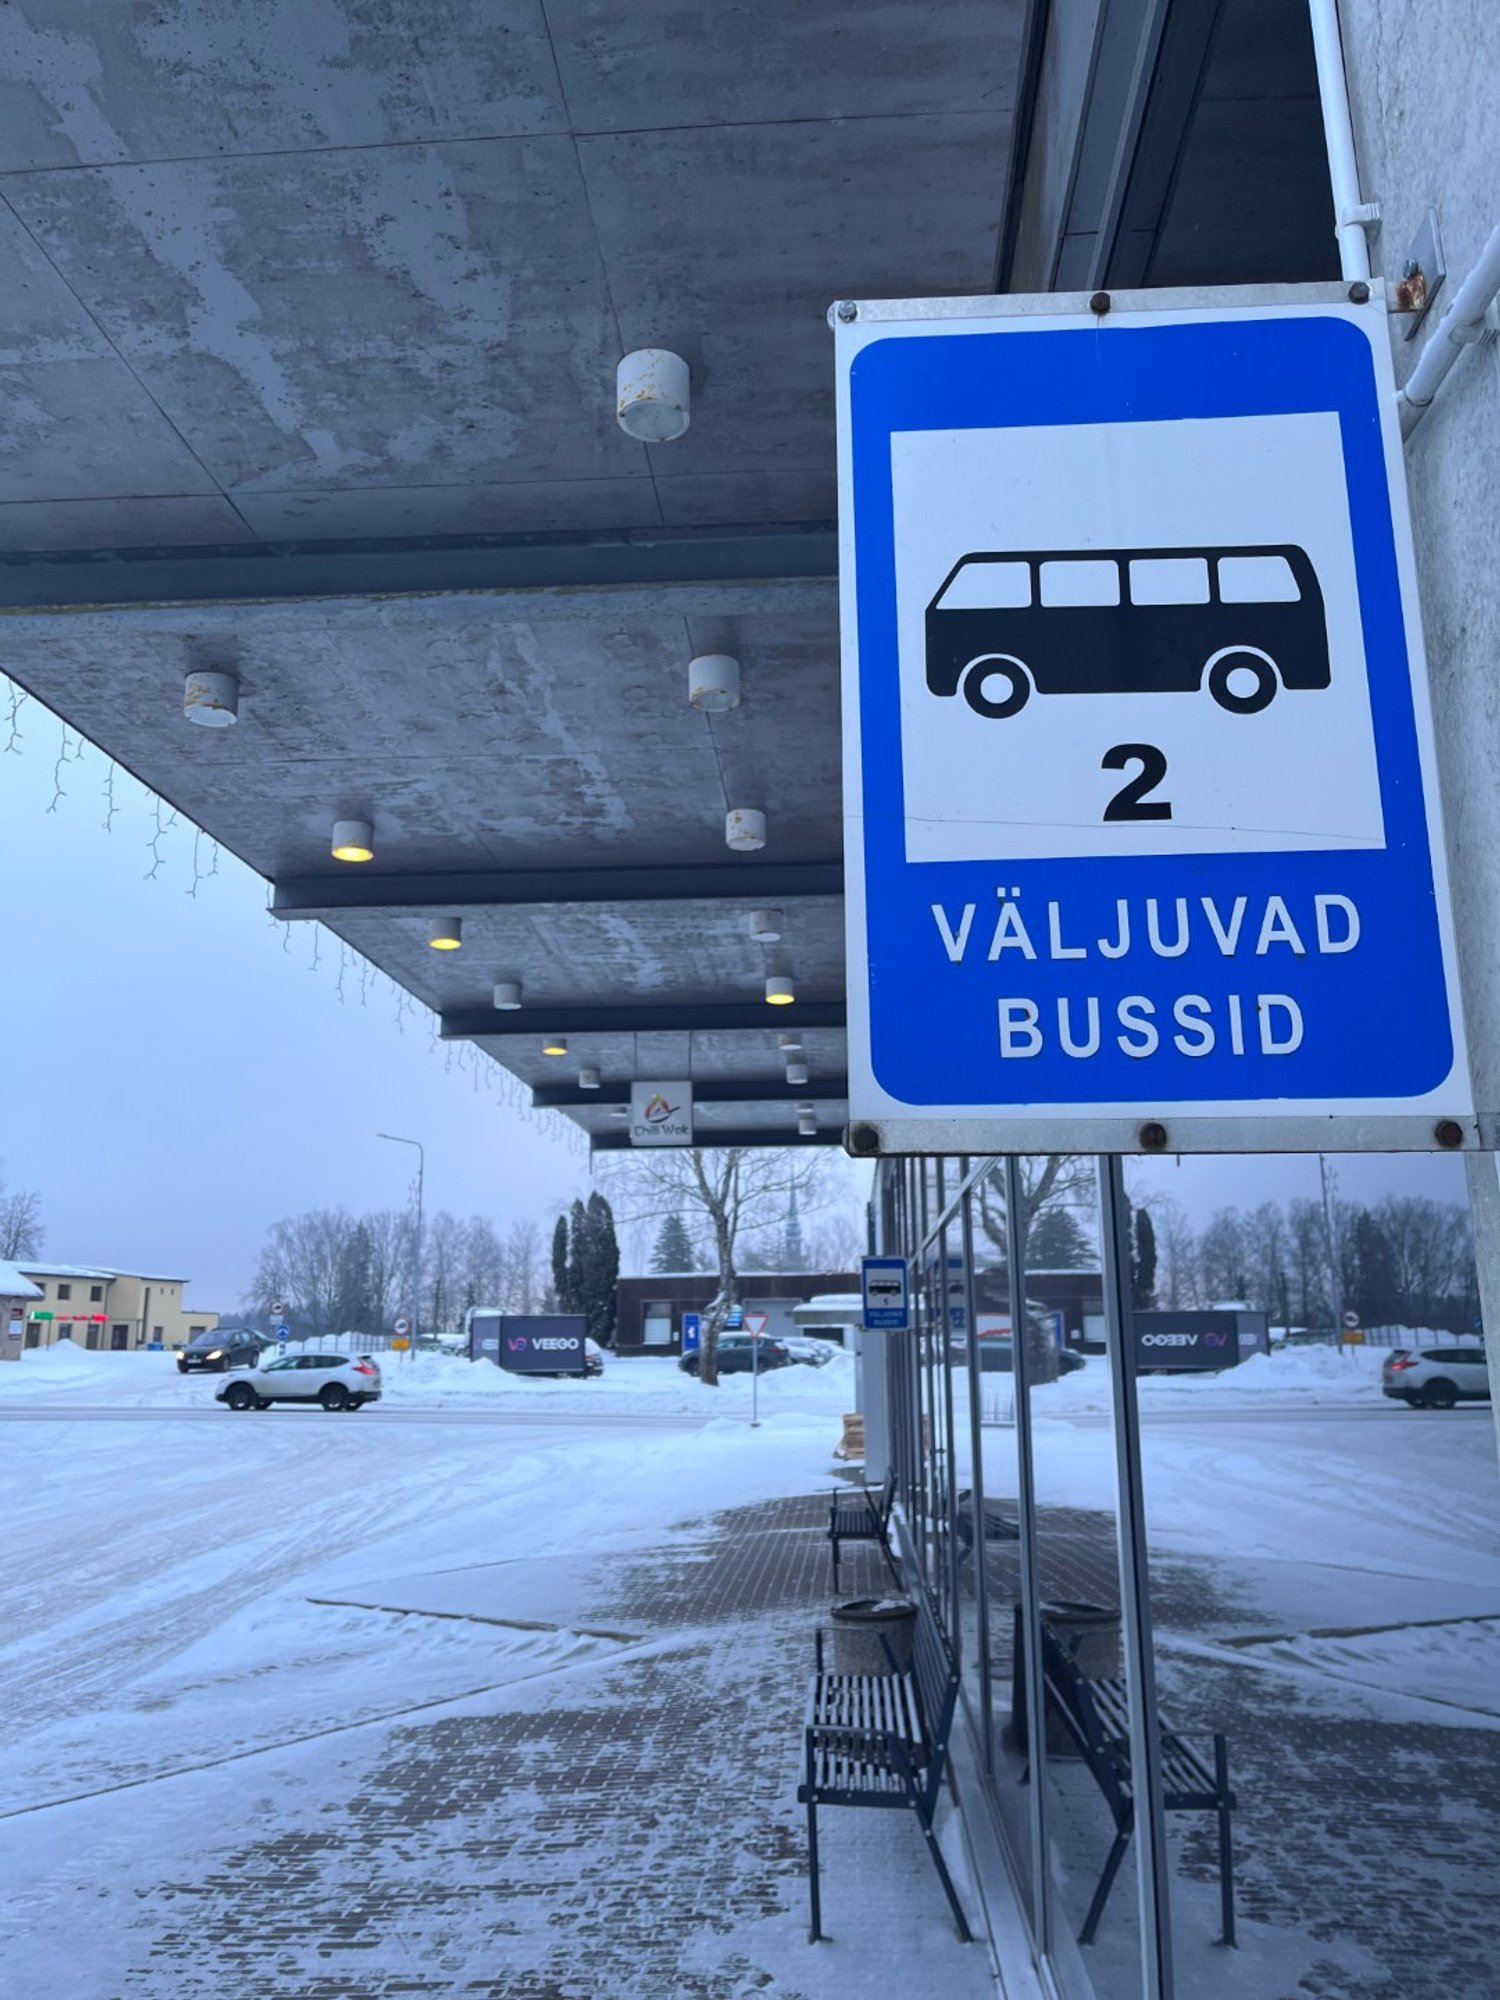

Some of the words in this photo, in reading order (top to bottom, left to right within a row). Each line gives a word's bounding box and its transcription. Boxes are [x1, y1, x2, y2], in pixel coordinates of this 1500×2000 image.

[1101, 743, 1172, 822] 2
[932, 887, 1361, 962] VÄLJUVAD
[998, 994, 1304, 1059] BUSSID
[661, 1124, 688, 1136] Wok
[532, 1338, 579, 1350] VEEGO
